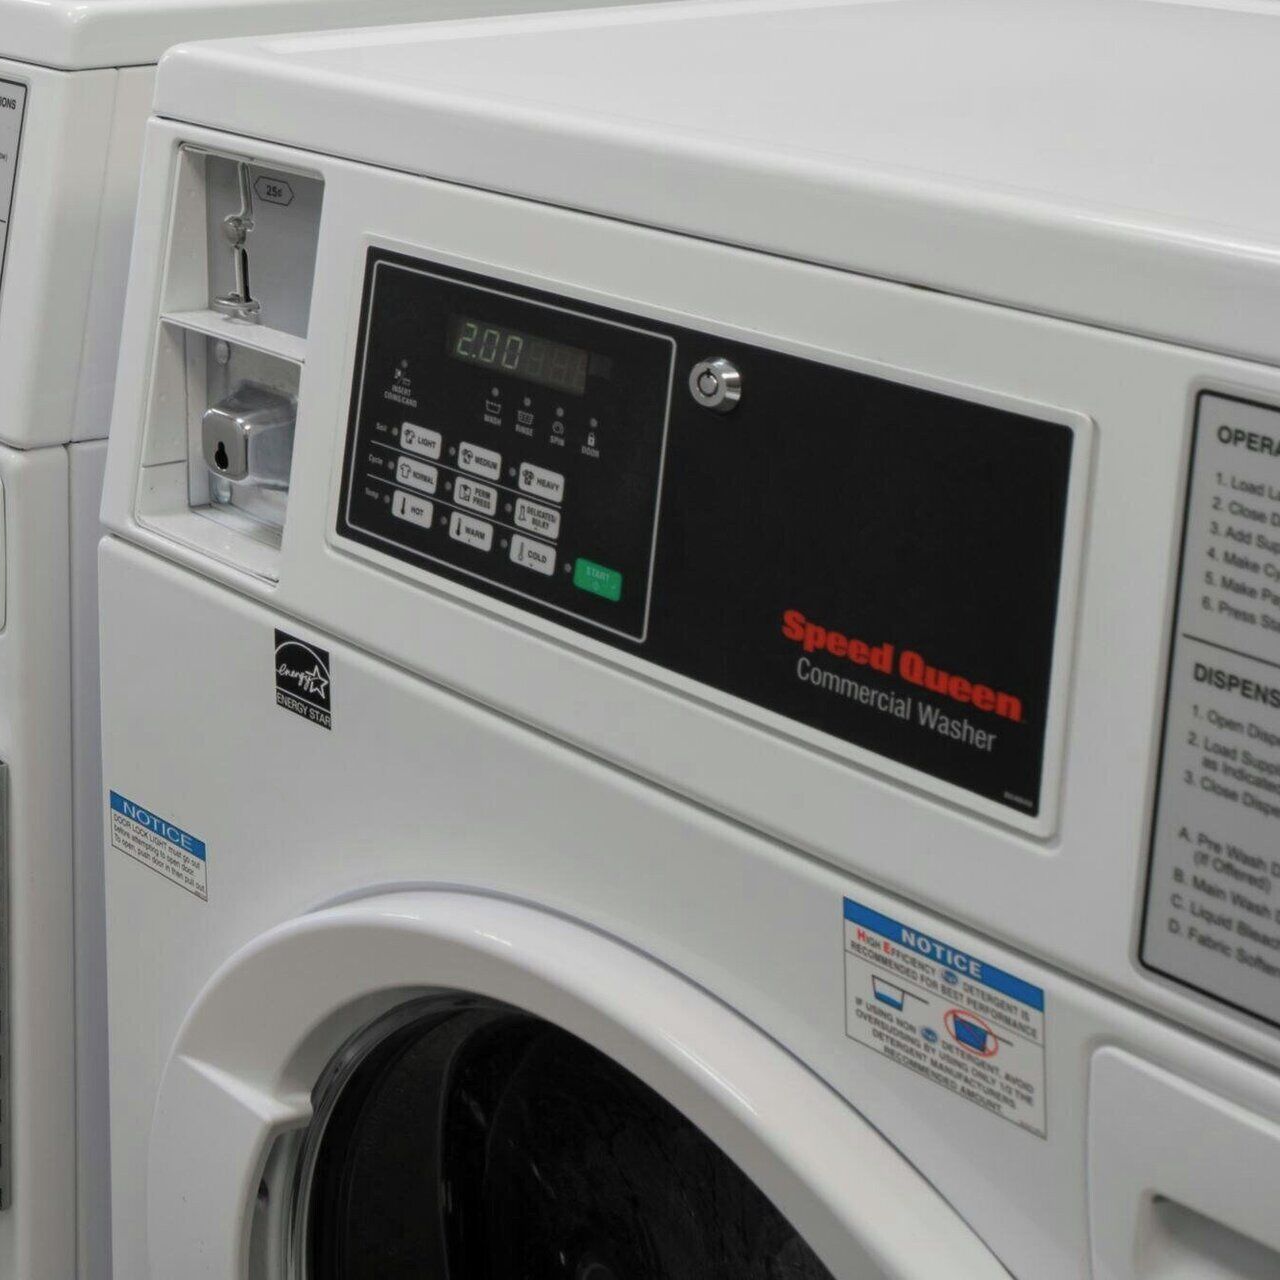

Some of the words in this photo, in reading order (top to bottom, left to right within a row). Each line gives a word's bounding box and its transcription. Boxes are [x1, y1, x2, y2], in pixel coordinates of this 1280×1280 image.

[456, 322, 524, 370] 2.00
[417, 436, 437, 449] LIGHT
[484, 414, 502, 426] WASH
[515, 424, 533, 436] RINSE
[550, 435, 566, 447] SPIN
[581, 445, 600, 458] DOOR
[412, 470, 435, 485] NORMAL
[474, 455, 498, 470] MEDIUM
[536, 478, 560, 491] HEAVY
[1230, 475, 1265, 498] Load
[411, 506, 424, 517] HOT
[1212, 496, 1223, 511] 2.
[1228, 500, 1267, 524] Close
[464, 526, 486, 540] WARM
[1226, 525, 1252, 545] Add
[527, 549, 547, 564] COLD
[1224, 550, 1260, 574] Make
[586, 565, 610, 582] START
[1221, 575, 1258, 599] Make
[1218, 600, 1257, 625] Press
[781, 609, 895, 675] Speed
[899, 649, 1022, 723] Queen
[276, 692, 308, 717] ENERGY
[309, 708, 331, 727] STAR
[796, 656, 912, 721] Commercial
[917, 700, 997, 752] Washer
[1207, 709, 1244, 733] Open
[1203, 736, 1238, 761] Load
[1200, 775, 1239, 802] Close
[113, 813, 131, 829] DOOR
[132, 823, 149, 839] LOCK
[149, 833, 167, 850] LIGHT
[168, 846, 182, 859] must
[123, 801, 194, 852] NOTICE
[113, 824, 131, 839] before
[132, 834, 159, 857] attempting
[167, 854, 181, 869] open
[1197, 832, 1223, 854] Pre
[1225, 843, 1268, 870] Wash
[152, 854, 164, 868] door
[172, 866, 184, 880] then
[184, 874, 195, 887] pull
[1212, 857, 1272, 895] Offered)
[1192, 874, 1227, 901] Main
[1230, 890, 1272, 919] Wash
[1190, 901, 1233, 932] Liquid
[901, 928, 983, 979] NOTICE
[1188, 925, 1232, 958] Fabric
[850, 940, 919, 981] RECOMMENDED
[920, 973, 939, 991] FOR
[940, 983, 964, 1000] BEST
[966, 996, 1038, 1039] PERFORMANCE
[883, 939, 937, 976] EFFICIENCY
[962, 981, 1018, 1015] DETERGENT
[1021, 1009, 1030, 1022] IS
[866, 1002, 894, 1022] USING
[896, 1017, 917, 1035] NON
[1004, 1072, 1035, 1094] AVOID
[872, 1028, 927, 1061] DETERGENT
[883, 1045, 958, 1090] RECOMMENDED
[923, 1042, 936, 1054] BY
[939, 1052, 969, 1073] USING
[971, 1067, 996, 1086] ONLY
[1015, 1088, 1035, 1107] THE
